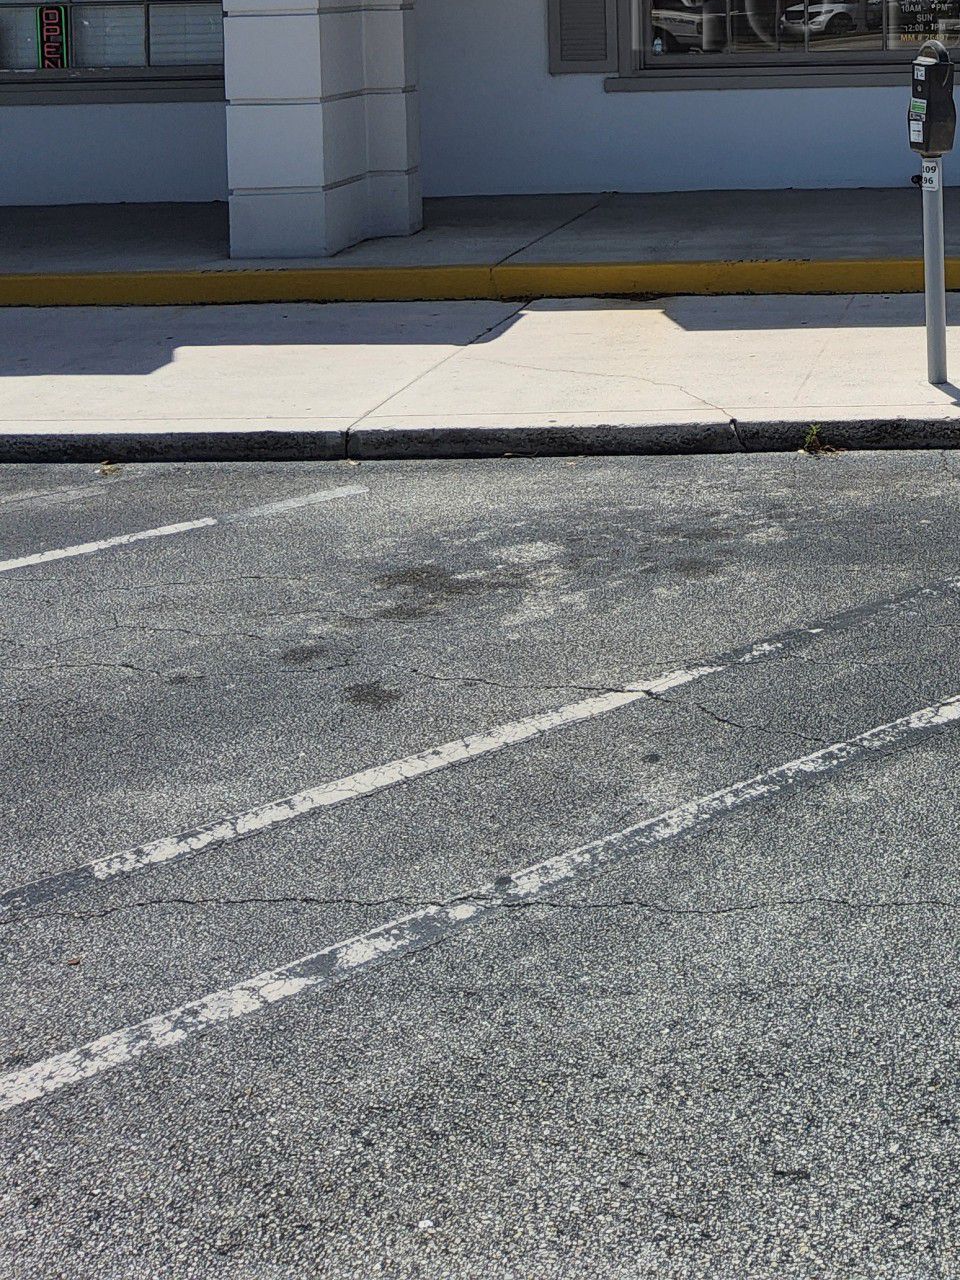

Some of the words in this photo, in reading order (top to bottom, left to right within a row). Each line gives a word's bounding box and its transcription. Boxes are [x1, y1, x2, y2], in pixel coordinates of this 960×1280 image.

[901, 4, 921, 12] 10AM
[916, 14, 933, 22] SUN
[42, 9, 61, 68] OPEN
[922, 176, 934, 185] 96
